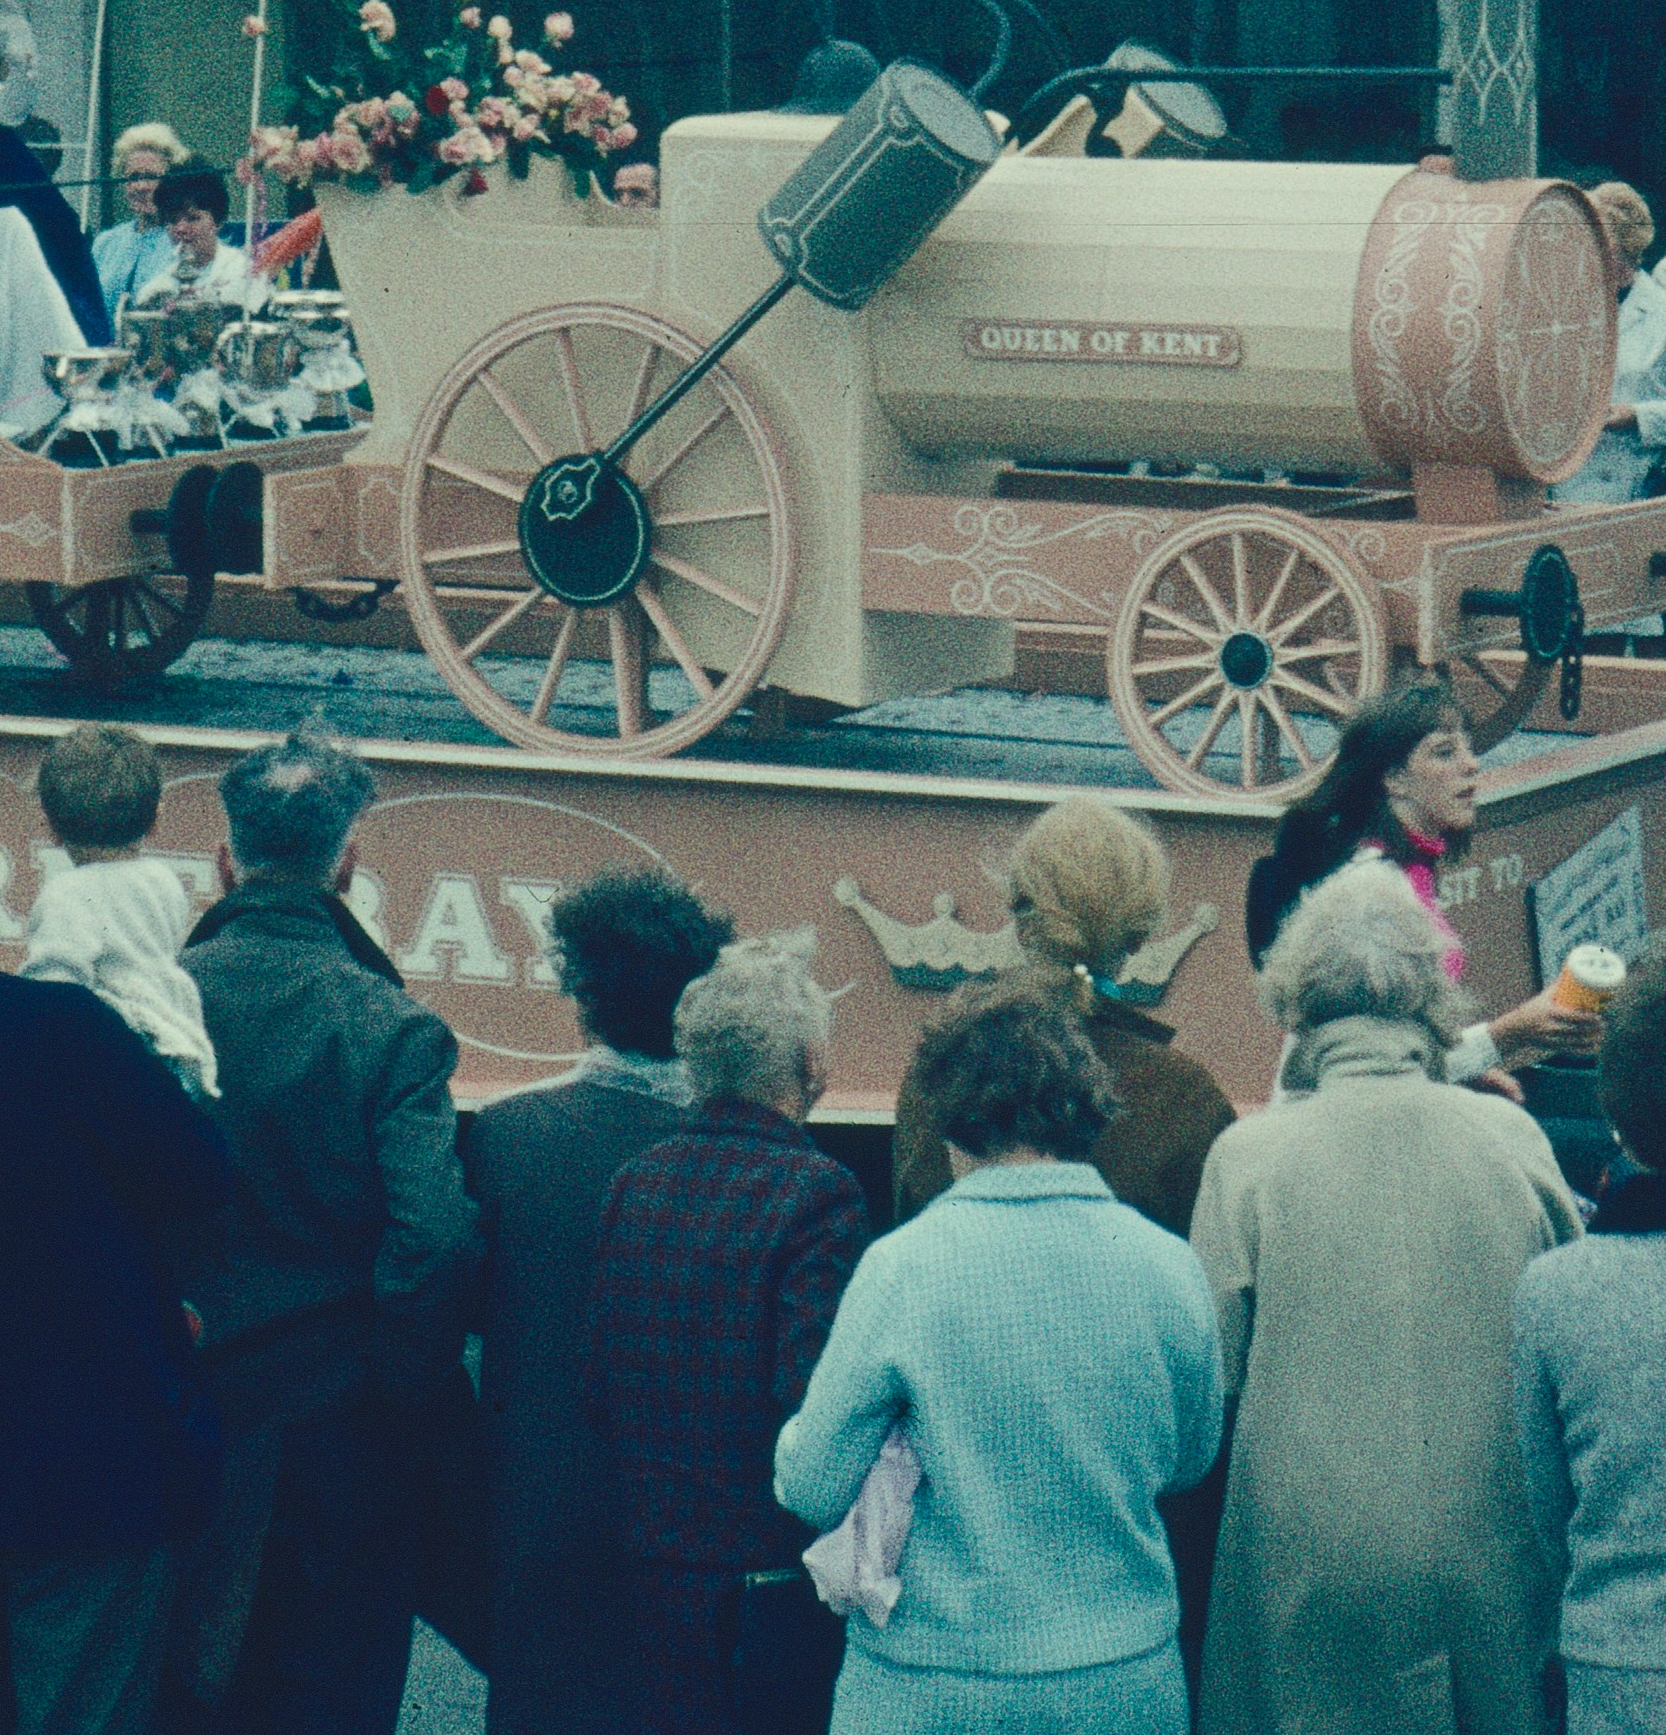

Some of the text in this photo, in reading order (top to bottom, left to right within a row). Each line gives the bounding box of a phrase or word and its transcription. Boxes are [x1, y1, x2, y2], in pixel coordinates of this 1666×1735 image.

[981, 326, 1221, 356] QUEEN OF KENT
[1436, 865, 1483, 909] SIT
